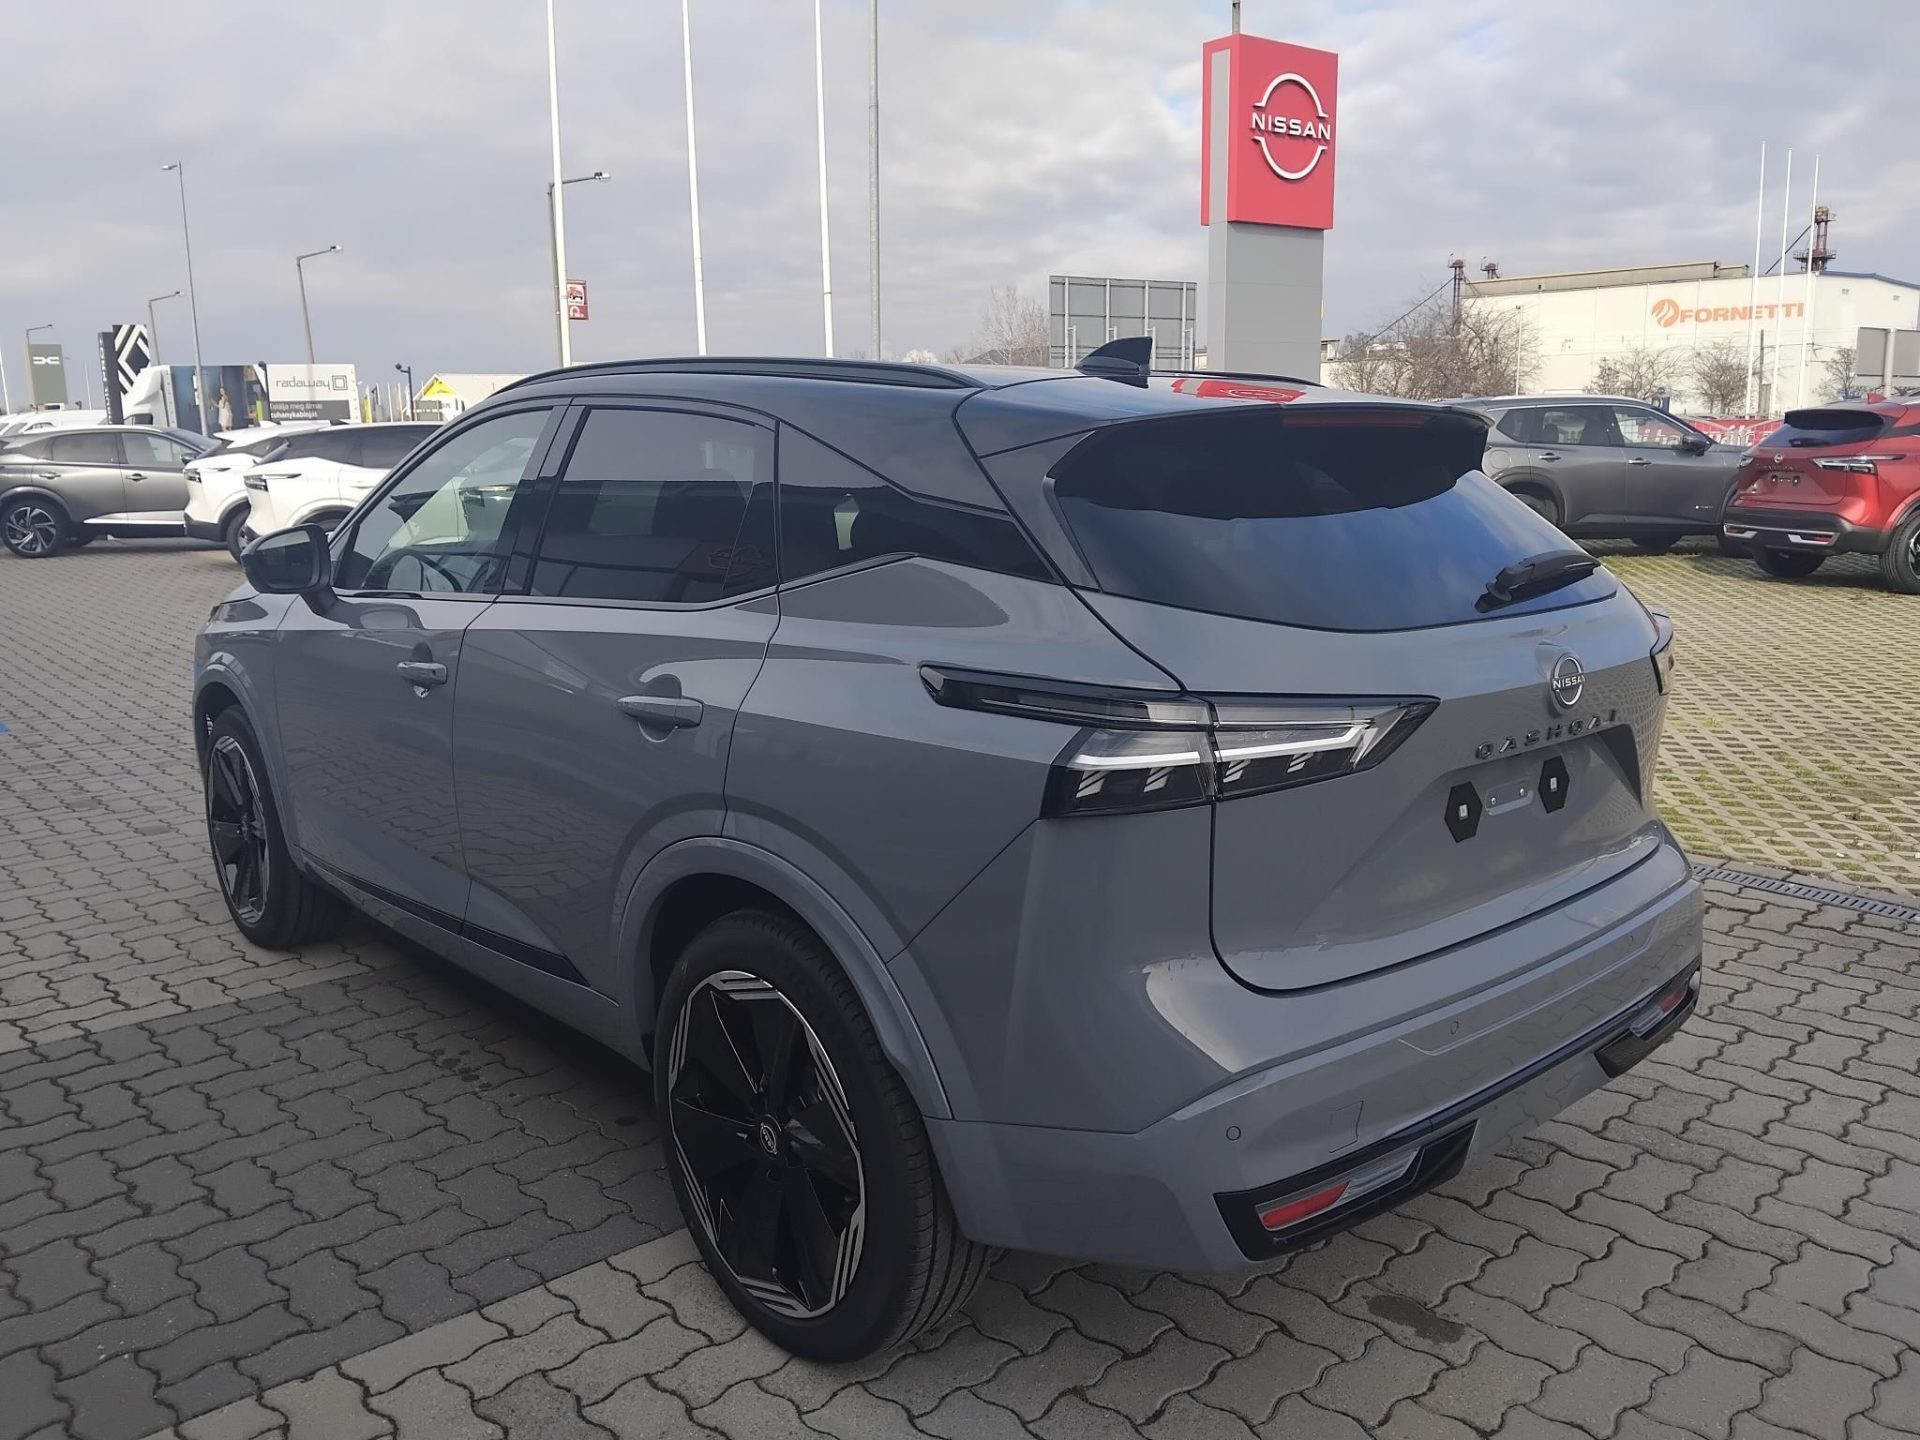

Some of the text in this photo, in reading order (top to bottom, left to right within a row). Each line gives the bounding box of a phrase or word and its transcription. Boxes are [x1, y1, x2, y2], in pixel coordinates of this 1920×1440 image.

[1252, 112, 1331, 140] NISSAN
[1680, 302, 1805, 324] FORNETTI
[275, 375, 331, 391] radaway
[1475, 709, 1616, 760] QASHQAI
